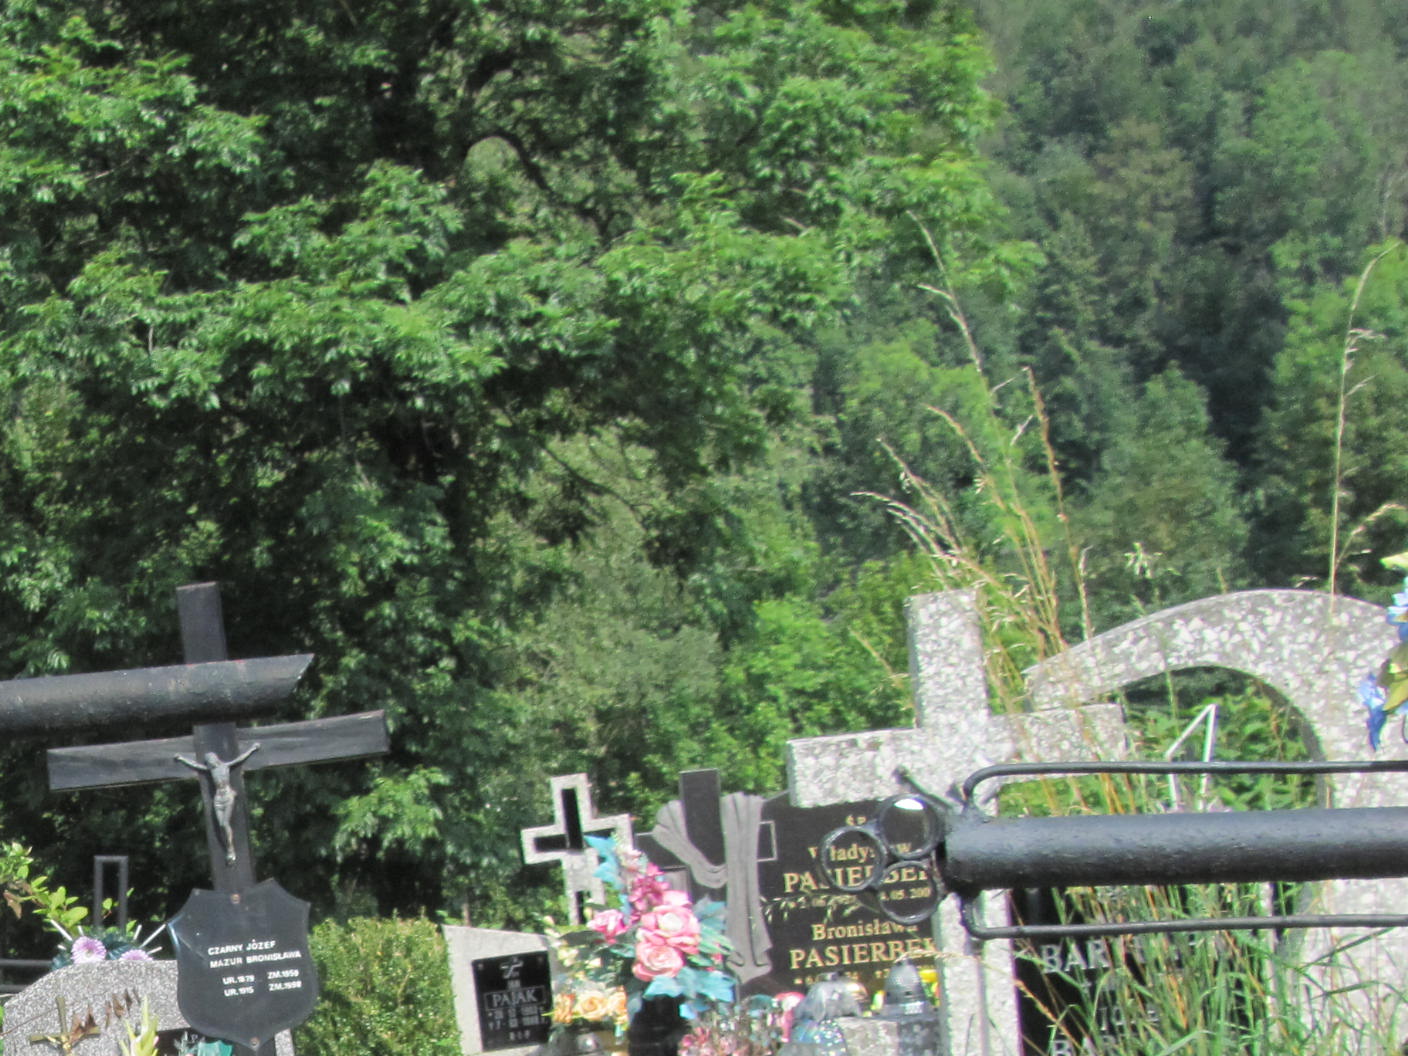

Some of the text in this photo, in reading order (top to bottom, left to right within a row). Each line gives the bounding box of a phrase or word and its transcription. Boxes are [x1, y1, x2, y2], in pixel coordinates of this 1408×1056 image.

[208, 938, 276, 956] CZARNY JÓZEF
[210, 956, 243, 968] MAZUR
